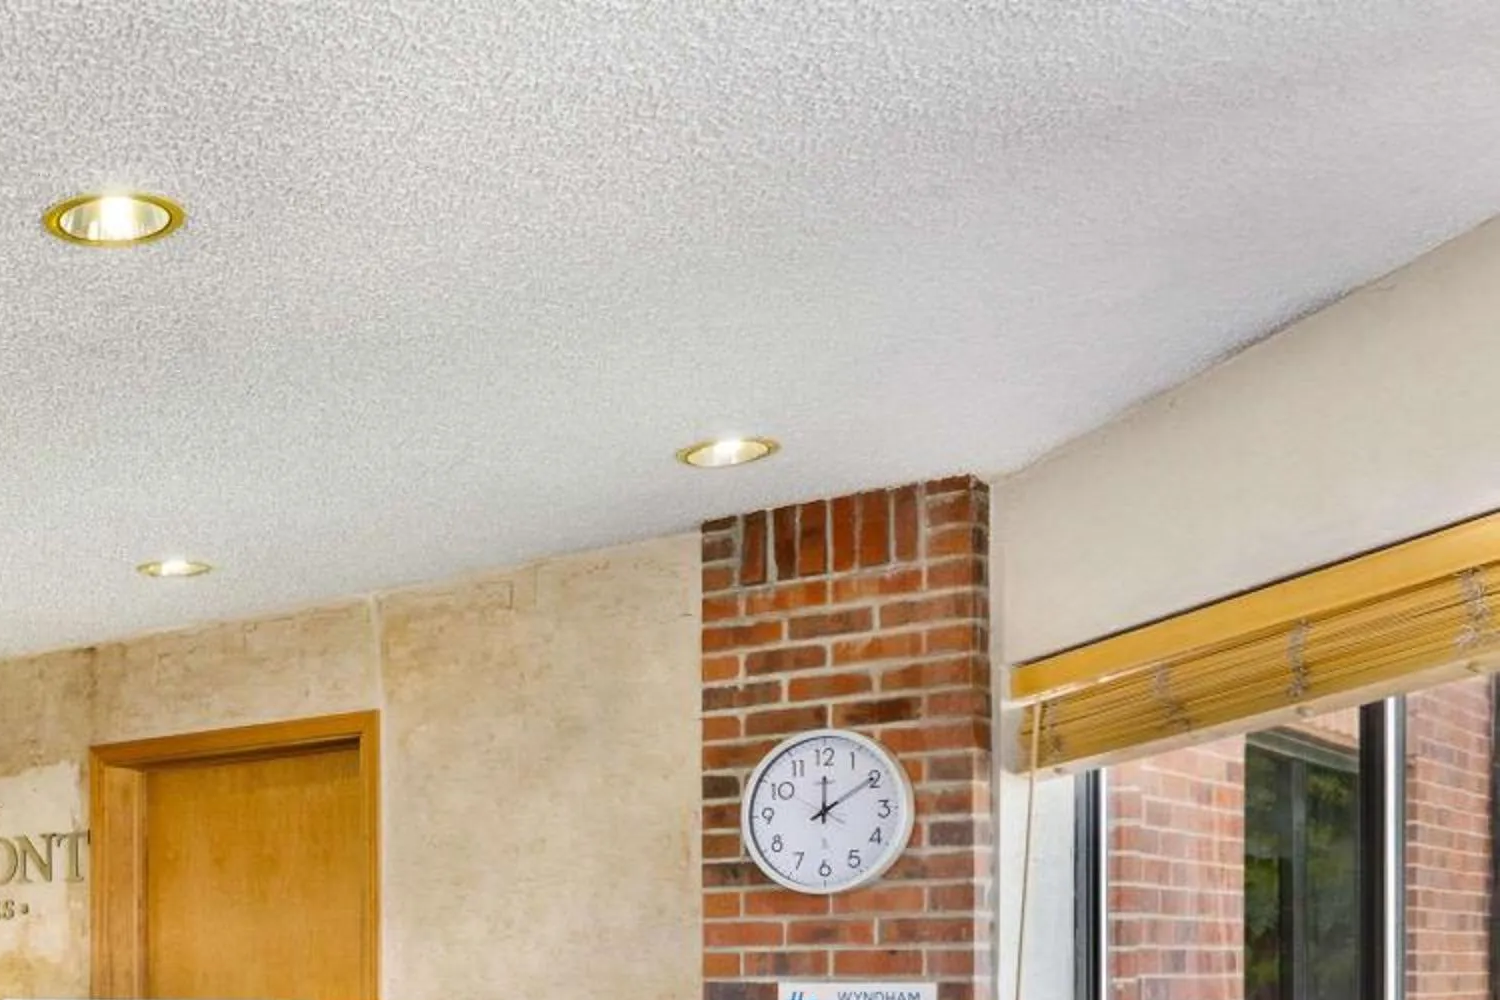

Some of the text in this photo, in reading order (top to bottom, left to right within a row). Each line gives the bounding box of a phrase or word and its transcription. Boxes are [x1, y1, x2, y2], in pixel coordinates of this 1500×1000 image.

[815, 747, 835, 767] 12
[849, 751, 856, 770] 1
[791, 760, 805, 777] 11
[868, 769, 882, 788] 2
[771, 781, 795, 800] 10
[761, 807, 774, 824] 9
[877, 800, 891, 818] 3
[771, 834, 783, 852] 8
[869, 827, 882, 844] 4
[794, 852, 805, 870] 7
[818, 860, 831, 876] 6
[848, 850, 861, 868] 5
